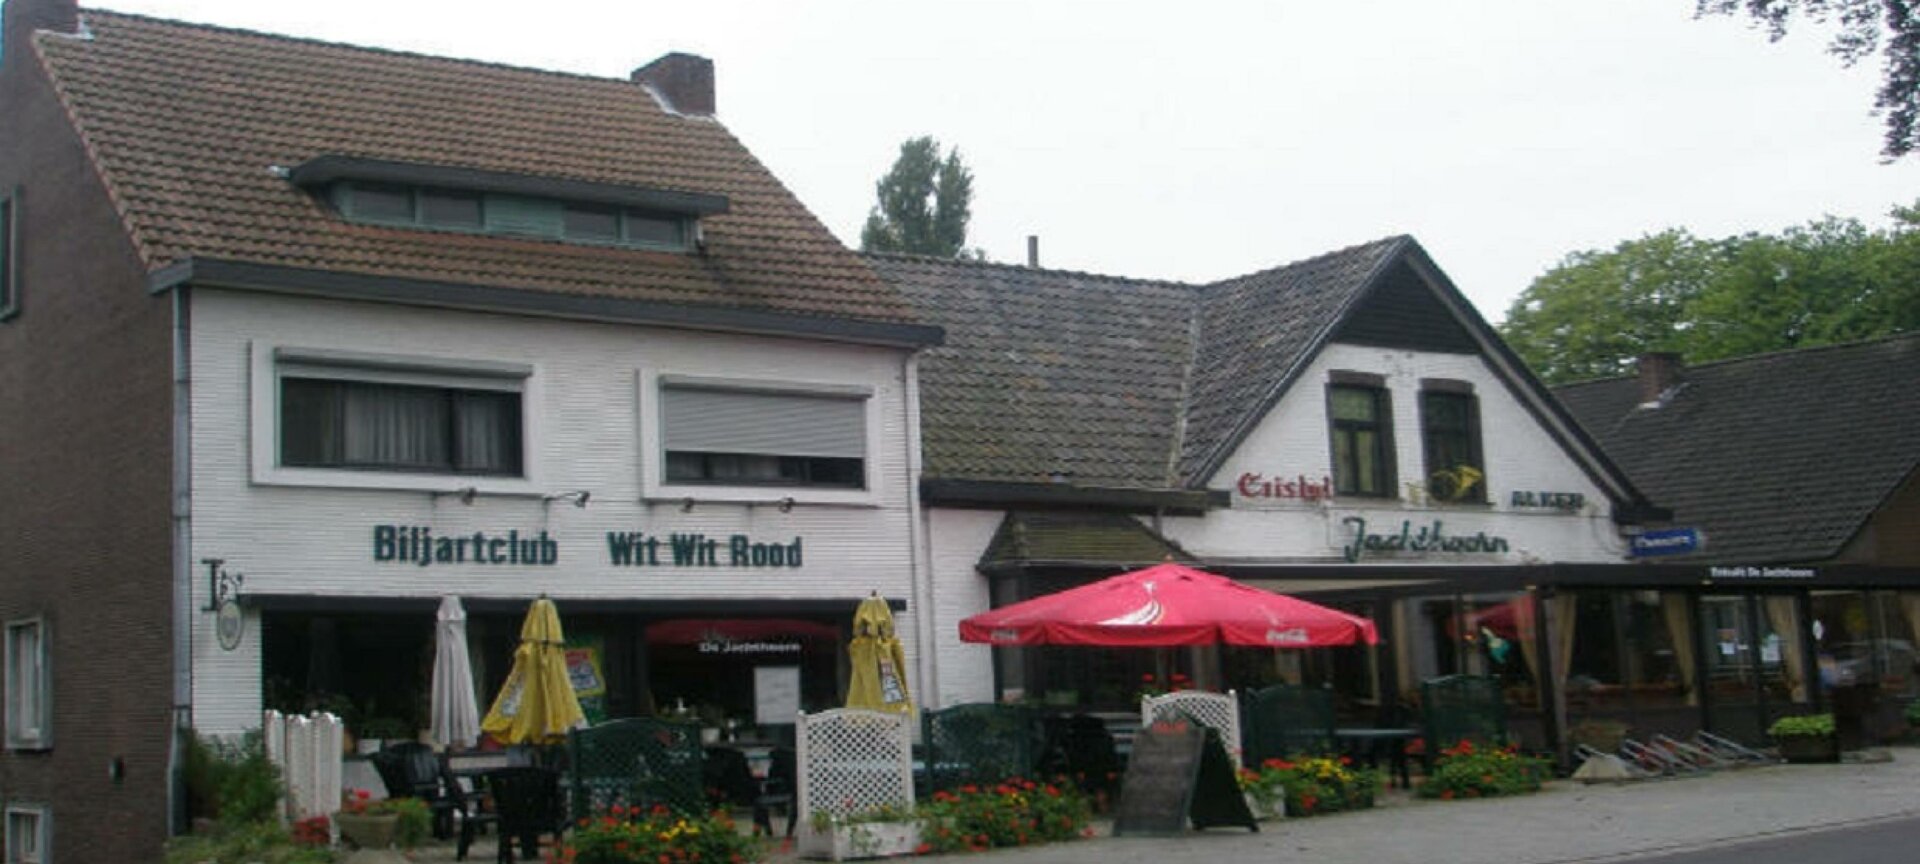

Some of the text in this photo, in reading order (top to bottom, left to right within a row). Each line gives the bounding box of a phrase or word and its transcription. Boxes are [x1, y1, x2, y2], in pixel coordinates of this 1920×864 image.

[373, 525, 803, 568] Biljartclub Wit Wit Rood
